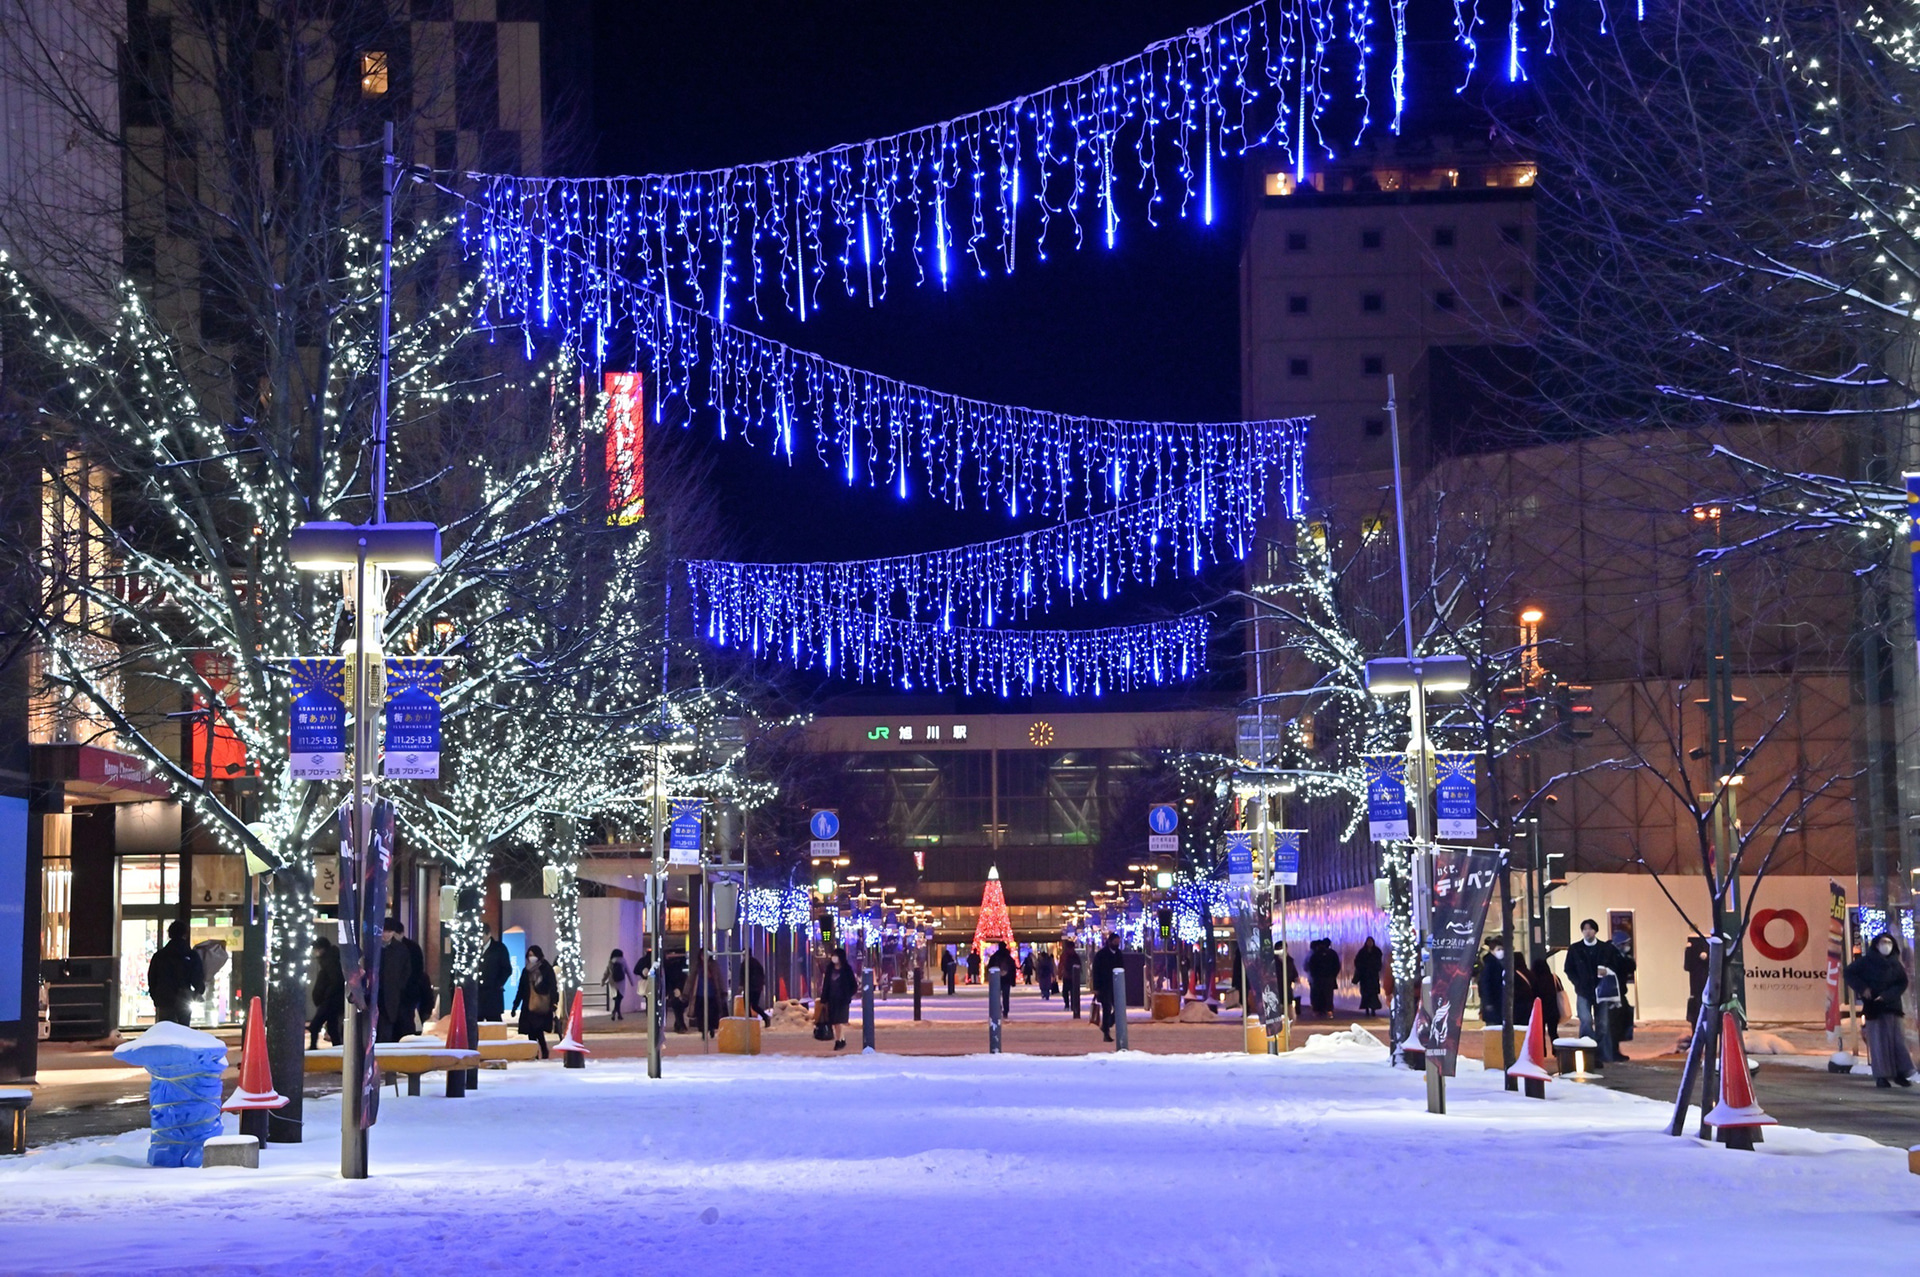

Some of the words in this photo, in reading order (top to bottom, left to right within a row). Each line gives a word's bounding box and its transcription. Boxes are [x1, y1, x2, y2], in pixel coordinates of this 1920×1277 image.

[298, 713, 337, 724] 街あかり
[867, 726, 890, 740] JR
[898, 725, 967, 740] 旭川駅
[1436, 870, 1495, 897] テッペン
[1743, 966, 1780, 979] aiwa
[1782, 967, 1828, 979] House
[1752, 983, 1813, 991] 大和ハウスグループ
